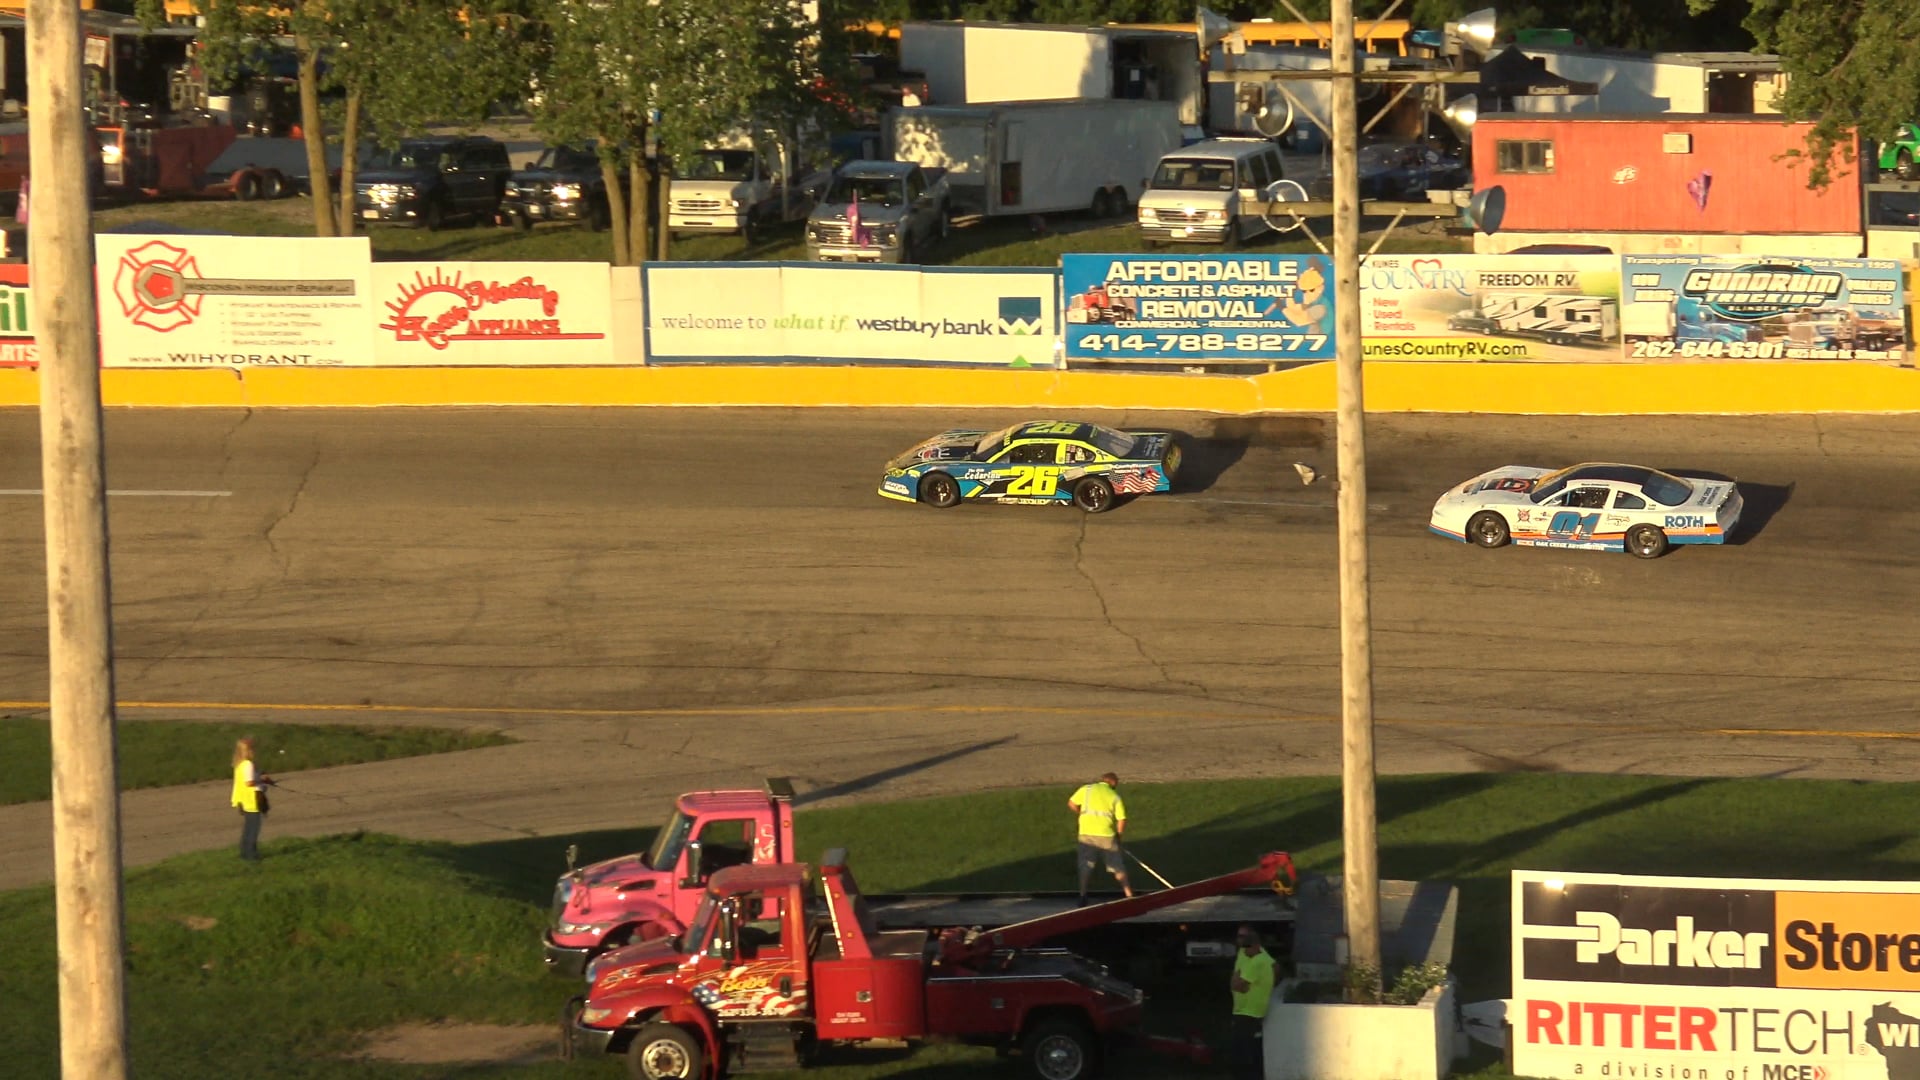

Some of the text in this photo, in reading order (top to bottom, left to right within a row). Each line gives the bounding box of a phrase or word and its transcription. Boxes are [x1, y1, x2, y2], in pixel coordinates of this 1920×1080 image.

[1105, 260, 1298, 282] AFFORDABLE
[1479, 273, 1576, 286] FREEDOM RV
[296, 284, 334, 292] REPAIR
[1685, 271, 1841, 294] GUNDRUM
[1107, 284, 1296, 299] CONCRETE & ASPHALT
[1705, 292, 1825, 305] TRUCKING
[1141, 300, 1263, 318] REMOVAL
[1373, 298, 1399, 306] New
[1373, 310, 1403, 319] Used
[662, 313, 744, 329] welcome
[748, 315, 767, 329] to
[773, 313, 825, 330] what
[856, 316, 941, 338] westbury
[943, 318, 994, 335] bank
[1114, 320, 1201, 329] COMMERCIAL
[1208, 320, 1291, 329] RESIDENTIAL
[1374, 321, 1417, 331] Rentals
[1079, 334, 1328, 352] 414-788-8277
[1363, 341, 1528, 358] unesCountryRV.com
[1632, 341, 1785, 359] 262-644-6301
[0, 344, 40, 361] RTS
[1024, 421, 1082, 434] 26
[1006, 466, 1061, 496] 26
[1547, 511, 1603, 540] 01
[1664, 516, 1704, 528] ROTH
[1575, 910, 1769, 969] Parker
[1784, 920, 1920, 973] Store
[1876, 1022, 1919, 1047] WI
[1574, 1061, 1812, 1080] a division of MCE
